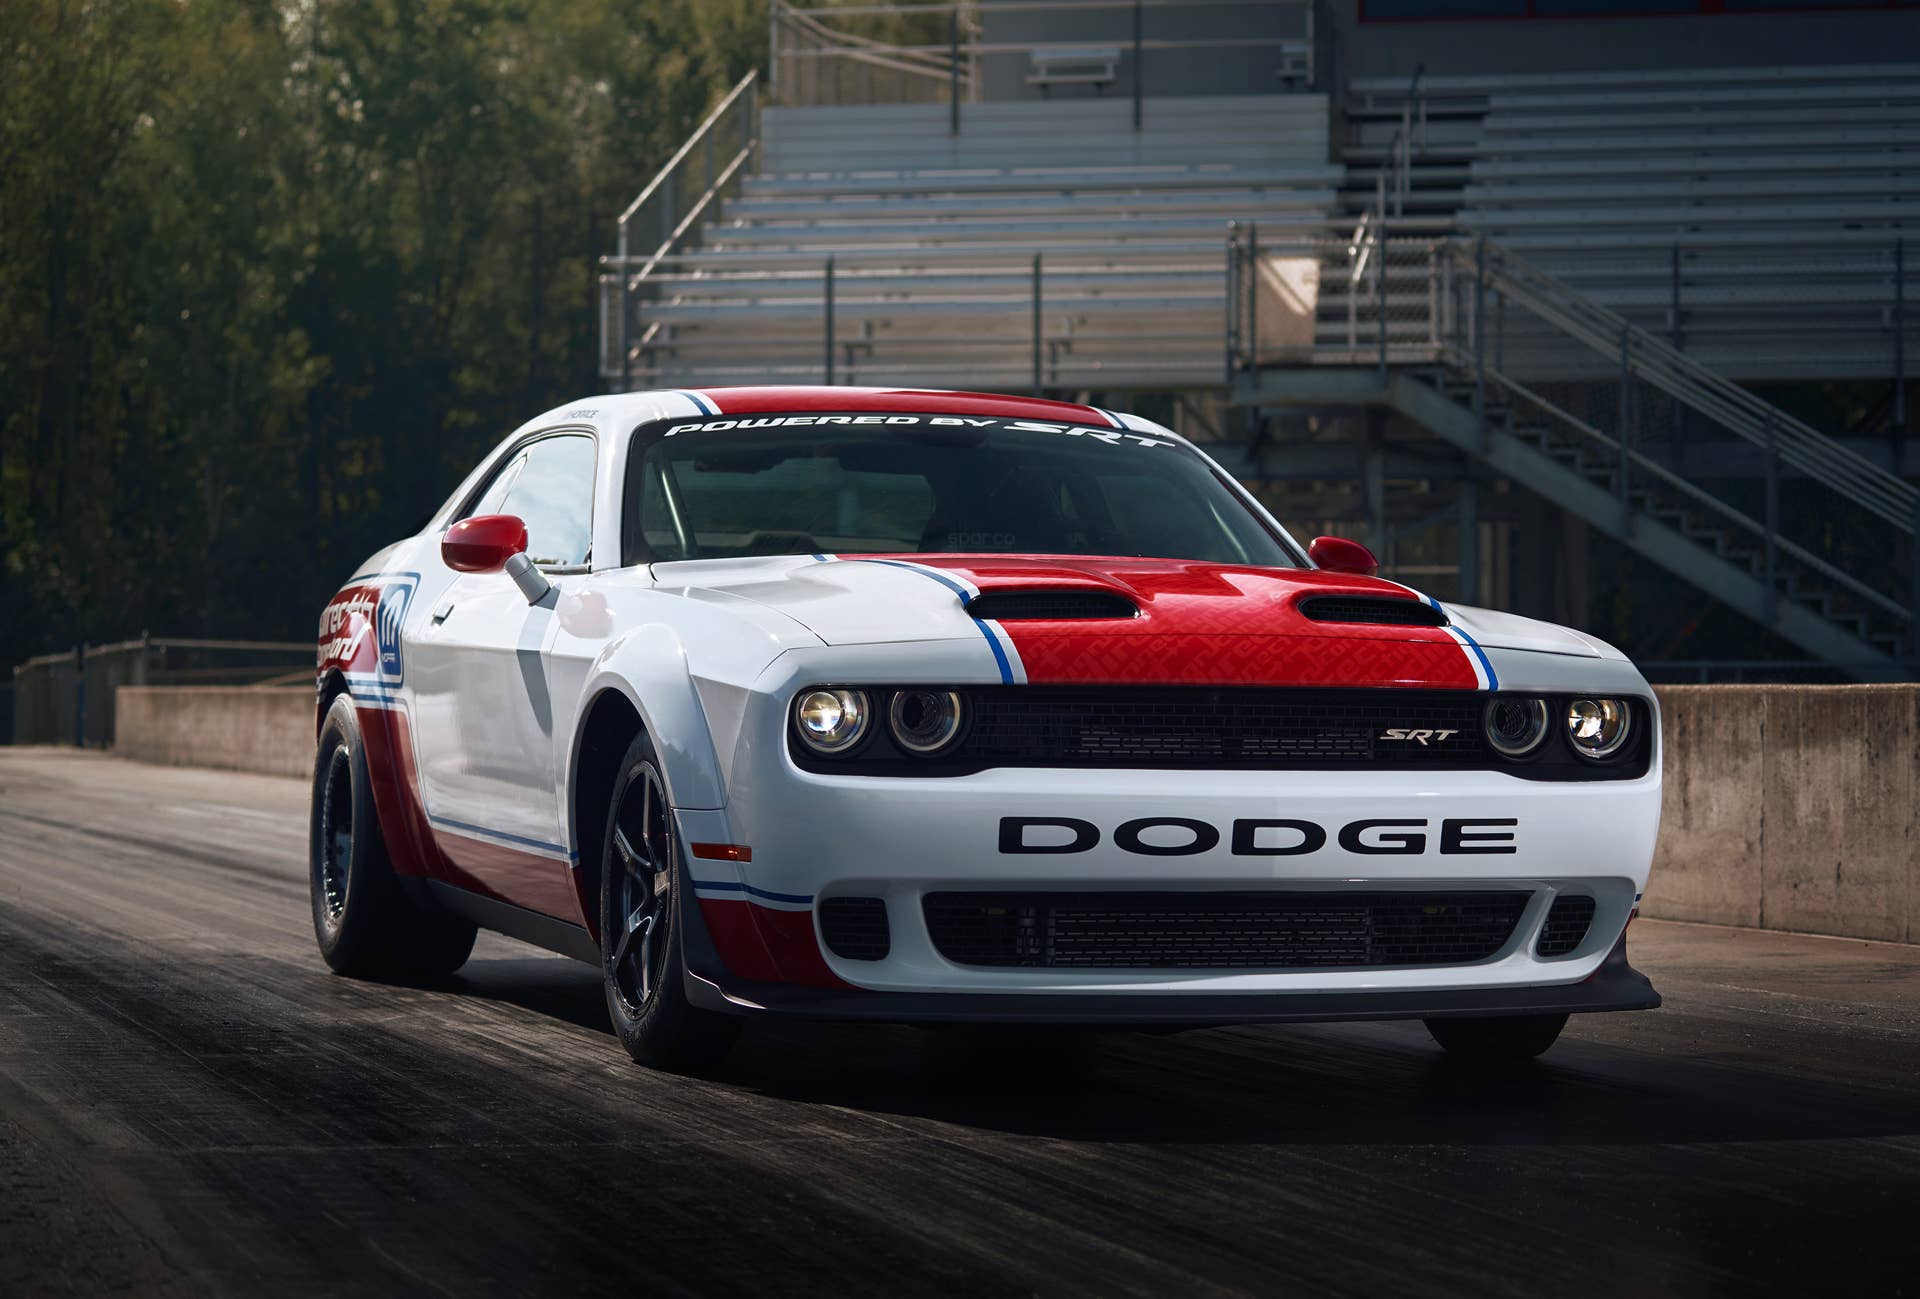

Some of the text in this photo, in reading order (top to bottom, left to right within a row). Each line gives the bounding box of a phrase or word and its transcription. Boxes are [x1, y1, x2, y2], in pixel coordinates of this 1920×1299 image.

[664, 416, 1176, 447] POWERED BY SRT
[948, 533, 1016, 546] sparco
[1379, 728, 1459, 746] SRT
[998, 816, 1519, 856] DODGE
